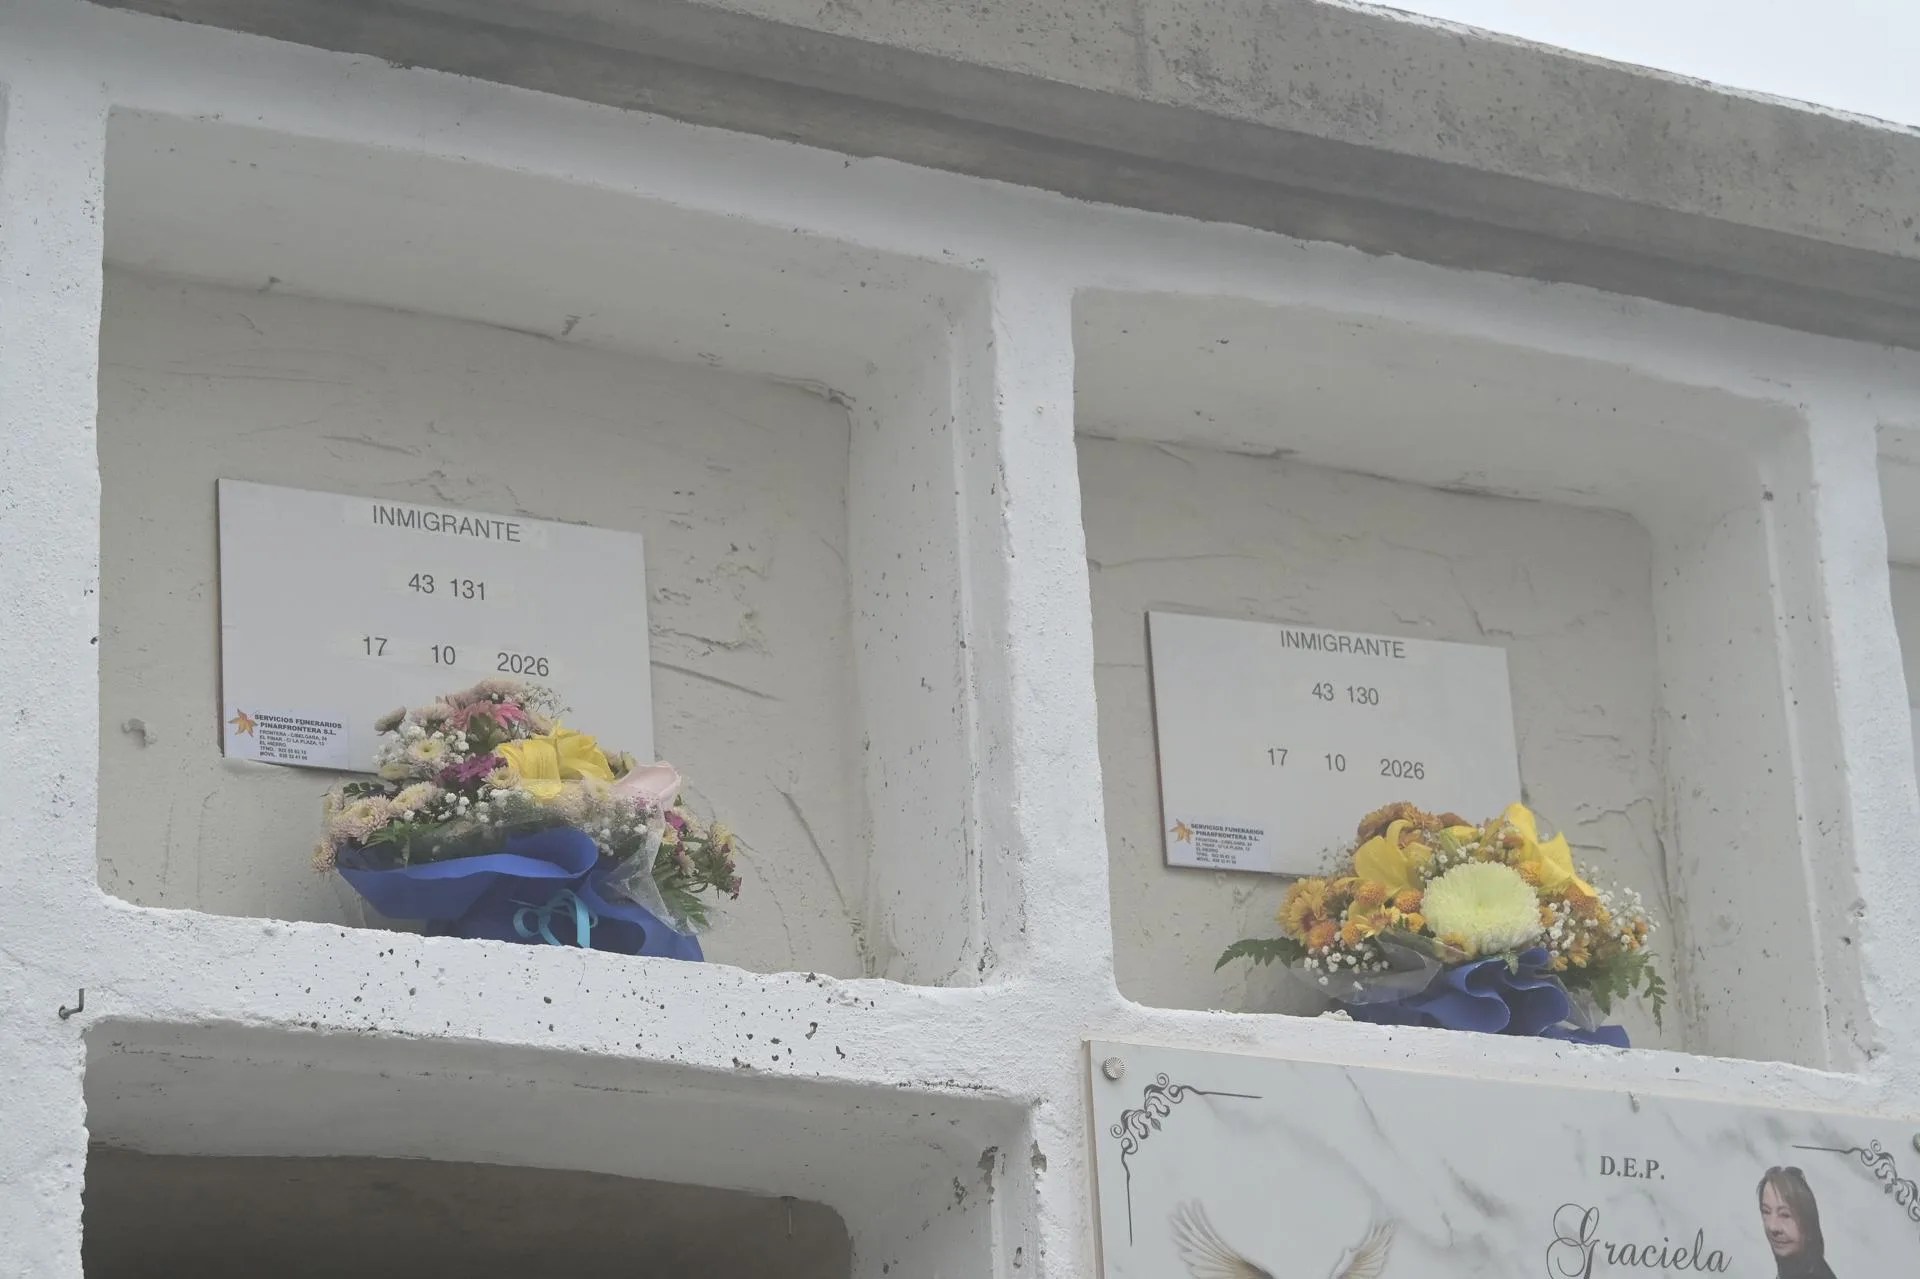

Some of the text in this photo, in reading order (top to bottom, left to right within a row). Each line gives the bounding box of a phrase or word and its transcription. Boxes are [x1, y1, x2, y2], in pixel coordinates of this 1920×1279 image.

[372, 505, 521, 543] INMIGRANTE
[408, 574, 486, 601] 43 131
[362, 636, 549, 677] 17 10 2026
[1280, 630, 1405, 659] INMIGRANTE
[1312, 683, 1379, 706] 43 130
[255, 714, 342, 729] SERVICIOS FUNERARIOS
[260, 722, 321, 734] PINARFRONTERA
[1267, 748, 1425, 780] 17 10 2026
[1600, 1155, 1665, 1180] D.E.P.
[1546, 1203, 1733, 1279] Graciela
